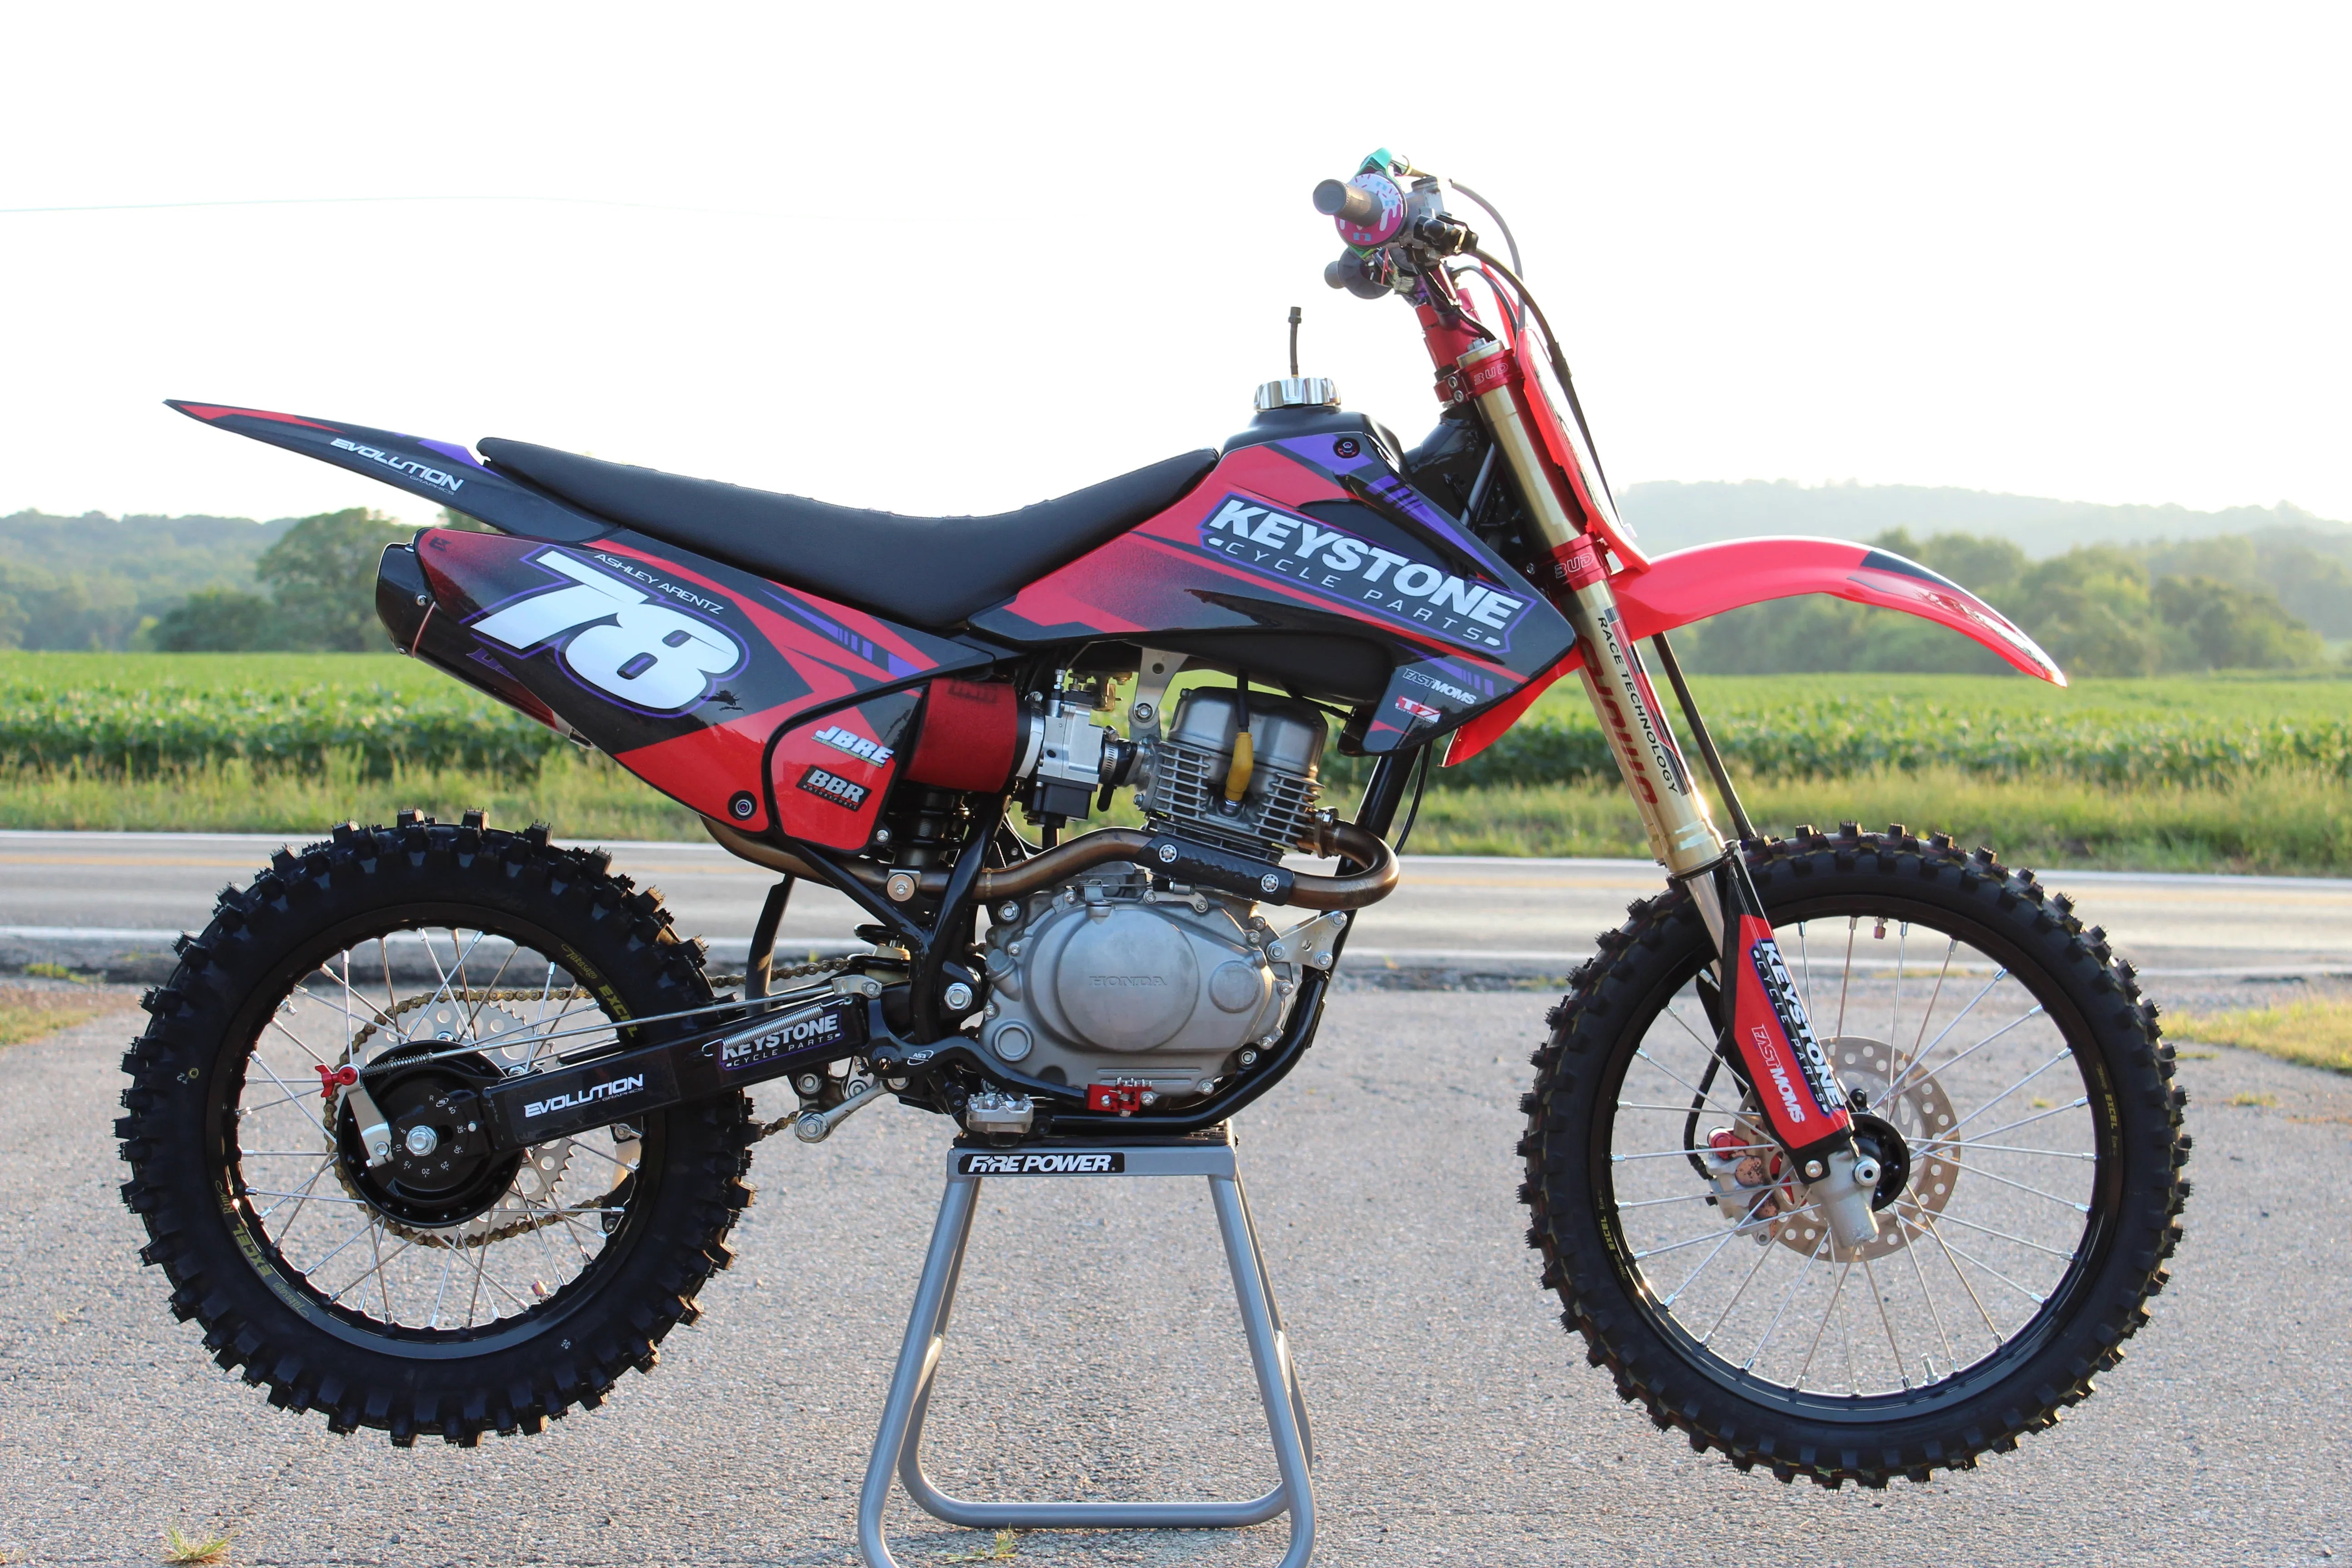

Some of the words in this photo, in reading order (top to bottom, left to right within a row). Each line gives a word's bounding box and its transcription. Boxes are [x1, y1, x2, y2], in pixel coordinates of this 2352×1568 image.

[1474, 363, 1509, 385] BUD
[330, 438, 464, 491] EVOLUTION
[410, 475, 455, 495] GRAPHICS
[1209, 499, 1524, 630] KEYSTONE
[1554, 552, 1594, 579] BUD
[593, 554, 659, 584] ASHLEY
[657, 583, 725, 614] ARENTZ
[1225, 542, 1342, 588] CYCLE
[1363, 589, 1483, 641] PARTS
[470, 550, 740, 709] 78
[1597, 617, 1625, 665] RACE
[1621, 669, 1678, 794] TECHNOLOGY
[815, 725, 895, 764] JBRE
[803, 784, 857, 810] MOTORSPORTS
[807, 769, 864, 803] BBR
[1089, 976, 1167, 987] HONDA
[1756, 960, 1791, 1024] CYCLE
[1791, 1038, 1825, 1102] PARTS
[1761, 942, 1844, 1107] KEYSTONE
[733, 1049, 778, 1066] CYCLE
[789, 1033, 833, 1051] PARTS
[448, 1106, 456, 1114] 40
[524, 1073, 643, 1118] EVOLUTION
[602, 1087, 644, 1101] GRAPHICS
[2105, 1094, 2117, 1129] EXCEL
[457, 1125, 463, 1133] 35
[396, 1144, 402, 1152] 10
[403, 1161, 412, 1169] 15
[454, 1145, 461, 1154] 30
[441, 1161, 449, 1170] 25
[1600, 1215, 1616, 1250] EXCEL
[233, 1223, 273, 1278] EXCEL
